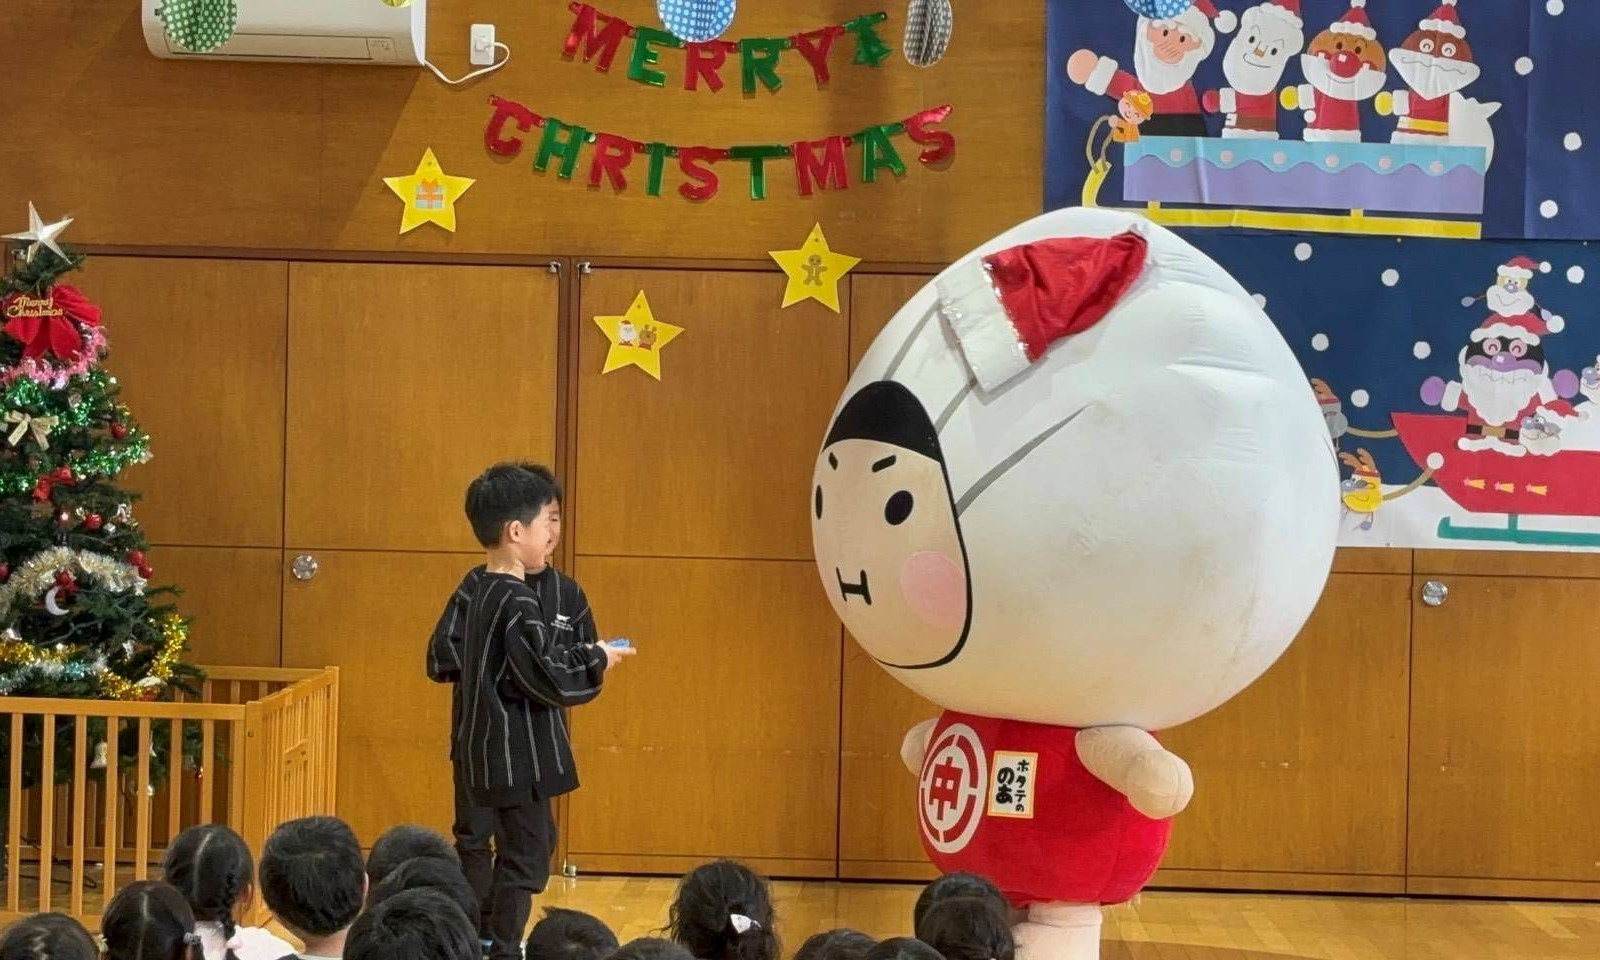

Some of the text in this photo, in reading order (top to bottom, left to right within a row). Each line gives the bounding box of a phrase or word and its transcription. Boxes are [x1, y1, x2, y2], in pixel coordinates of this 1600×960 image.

[561, 2, 846, 98] MERRY
[484, 94, 956, 201] CHRISTMAS
[7, 305, 63, 318] Christmas
[13, 295, 53, 309] Merry
[995, 767, 1014, 804] のあ
[1015, 759, 1030, 812] ホタテの
